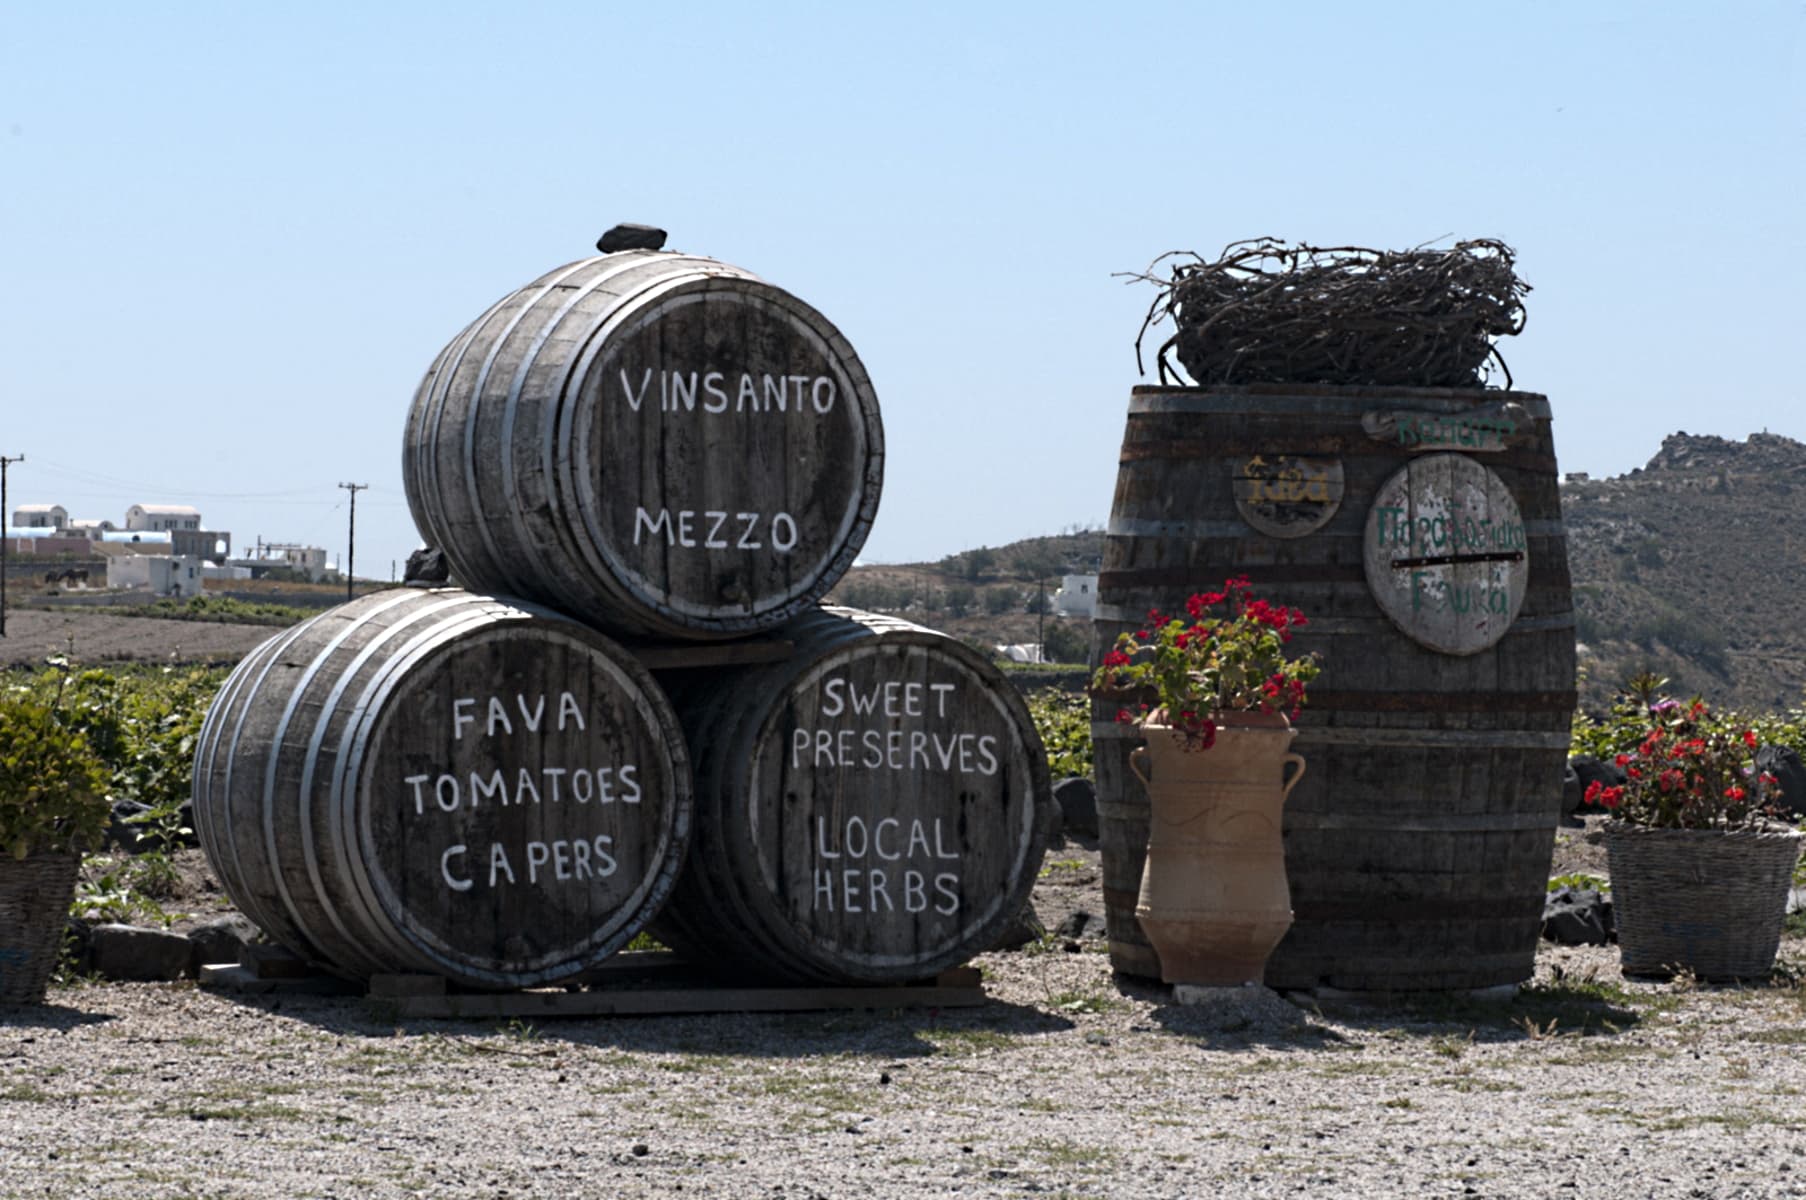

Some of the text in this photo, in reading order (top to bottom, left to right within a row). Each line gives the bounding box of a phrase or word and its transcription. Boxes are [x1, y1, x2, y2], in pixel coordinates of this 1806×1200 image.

[620, 368, 836, 413] VINSANTO
[633, 506, 797, 551] MEZZO
[453, 692, 586, 739] FAVA
[822, 679, 955, 718] SWEET
[792, 728, 998, 775] PRESERVES
[404, 765, 641, 814] TOMATOES
[819, 816, 959, 860] LOCAL
[441, 835, 617, 891] CAPERS
[814, 869, 960, 915] HERBS
